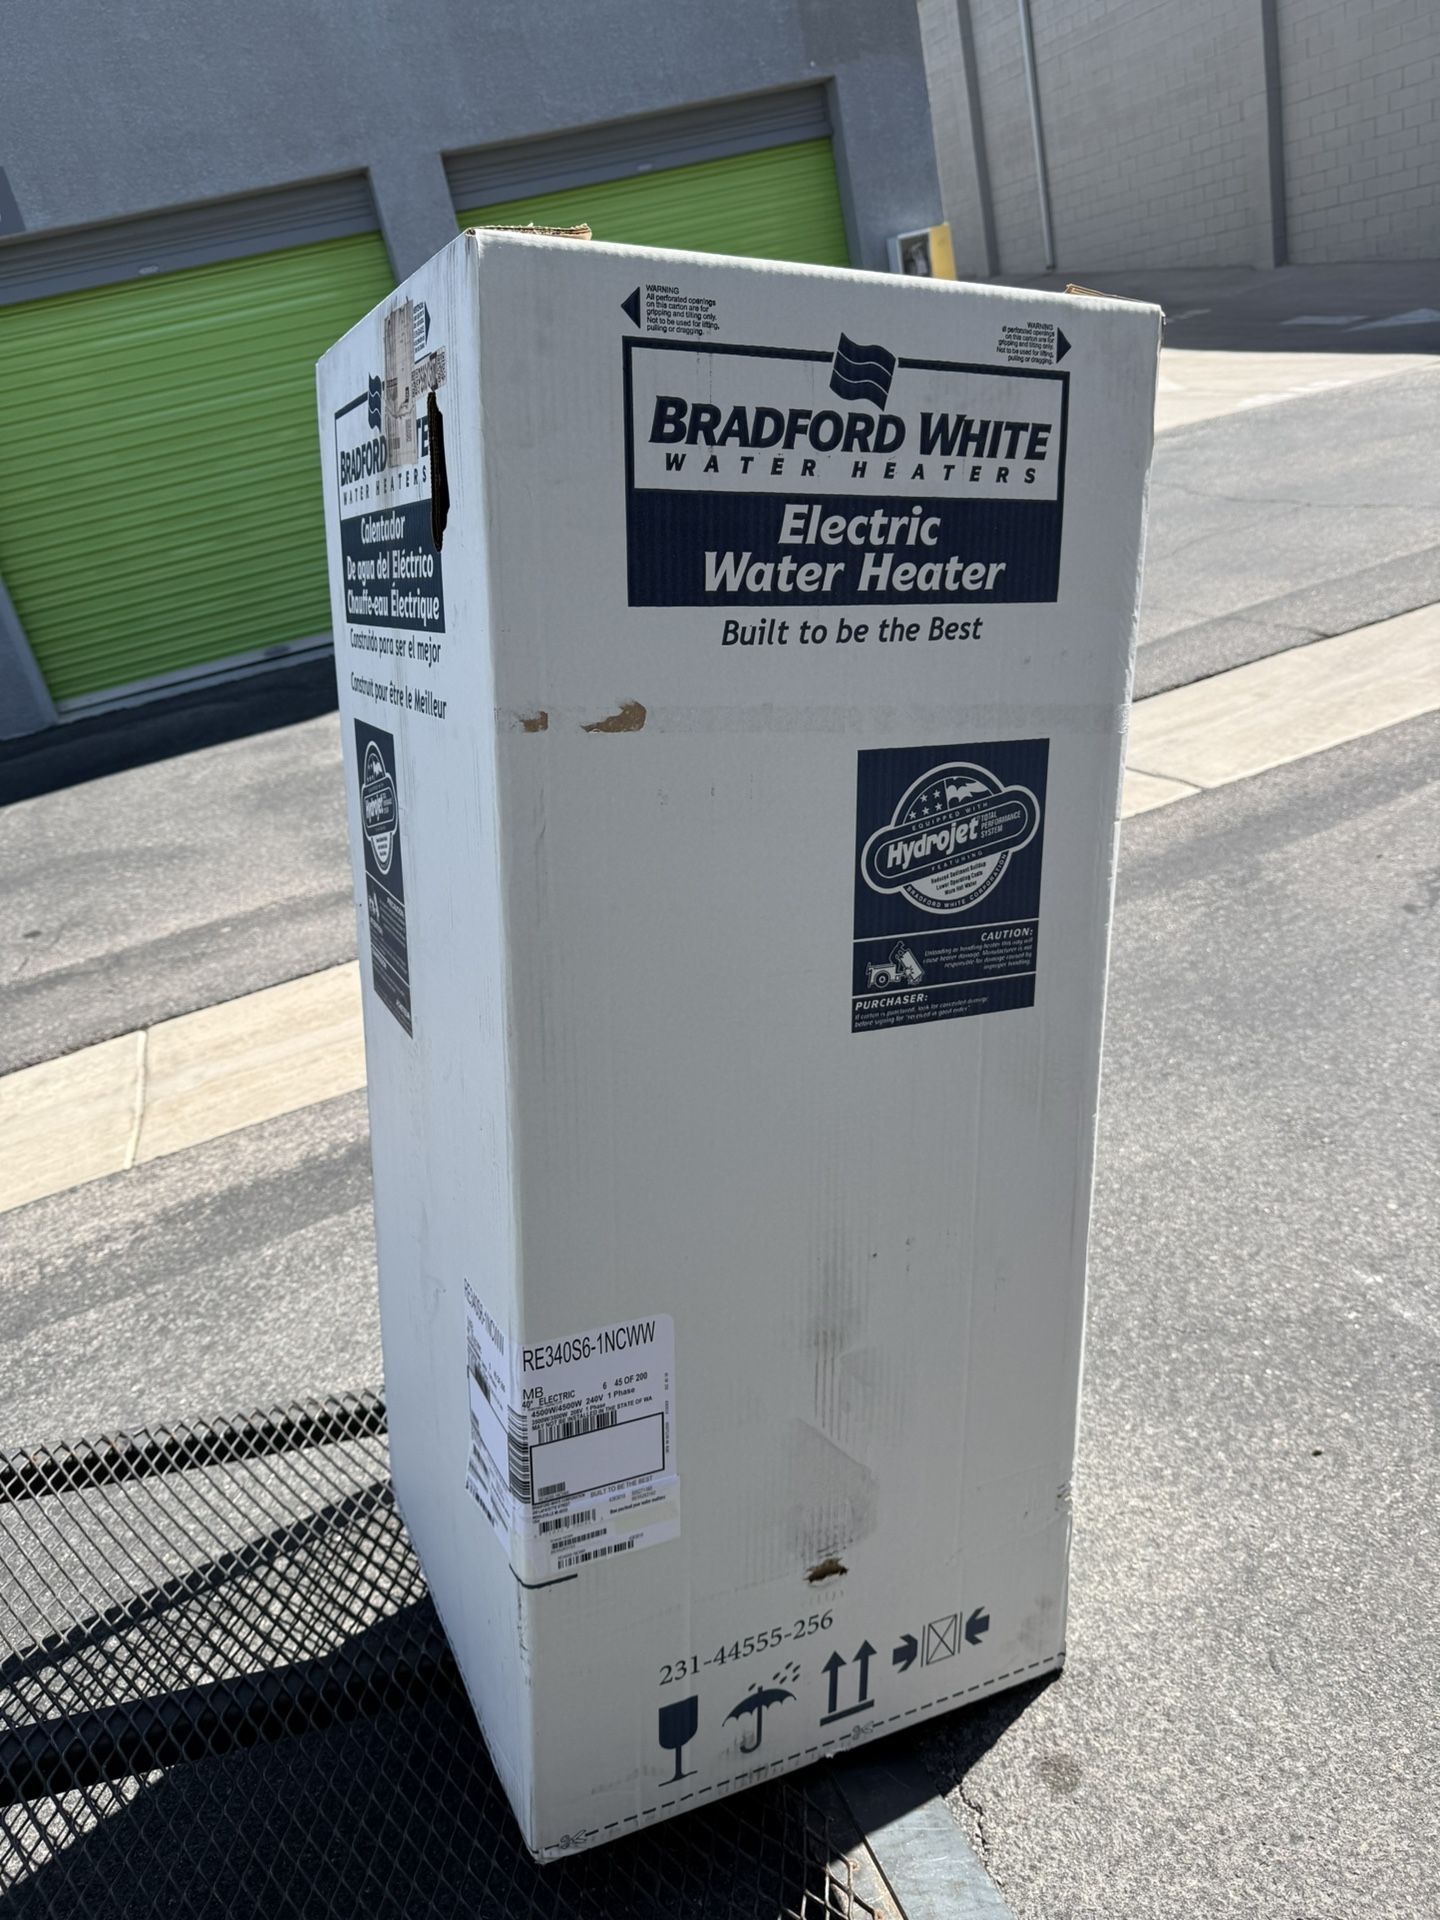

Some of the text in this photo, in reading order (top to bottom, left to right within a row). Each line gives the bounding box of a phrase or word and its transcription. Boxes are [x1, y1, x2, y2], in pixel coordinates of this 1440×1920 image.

[646, 284, 680, 295] WARNING
[646, 293, 716, 308] All perforated openings
[646, 308, 672, 318] gripping
[672, 310, 685, 318] and
[686, 311, 702, 321] tilting
[656, 301, 667, 309] this
[700, 305, 709, 313] for
[646, 316, 659, 324] Not
[666, 318, 675, 326] be
[676, 318, 692, 327] used
[692, 320, 702, 328] for
[646, 324, 668, 334] pulling
[648, 395, 1052, 460] BRADFORD WHITE
[340, 434, 388, 487] BRADFORD
[665, 452, 1036, 484] WATER HEATERS
[343, 465, 427, 506] WATER HEATERS
[360, 510, 406, 545] Calentador
[777, 503, 942, 546] Electric
[346, 546, 434, 587] De agua del Eléctrico
[704, 551, 1006, 592] Water Heater
[347, 581, 440, 627] Chauffe-eau Électrique
[721, 616, 984, 646] Built to be the Best
[350, 628, 441, 668] Construido para ser el mejor
[350, 671, 447, 720] Construit pour être le Meilleur
[911, 802, 988, 832] EQUIPPED WITH
[980, 810, 998, 821] TOTAL
[980, 810, 1022, 830] PERFORMANCE
[886, 817, 980, 870] Hydrojet
[980, 825, 1004, 839] SYSTEM
[931, 850, 984, 872] FEATURING
[906, 853, 1008, 909] BRADFORD WHITE CORPORATION
[980, 928, 1034, 942] CAUTION:
[854, 993, 928, 1012] PURCHASER:
[522, 1321, 656, 1372] RE340S6-1NCWW
[522, 1386, 544, 1400] MB
[602, 1372, 648, 1390] 6 45 OF 200
[538, 1390, 576, 1406] ELECTRIC
[586, 1394, 604, 1406] 240V
[613, 1388, 636, 1398] Phase
[616, 1482, 625, 1490] BE
[626, 1480, 638, 1488] THE
[638, 1475, 653, 1484] BEST
[658, 1609, 835, 1687] 231-44555-256
